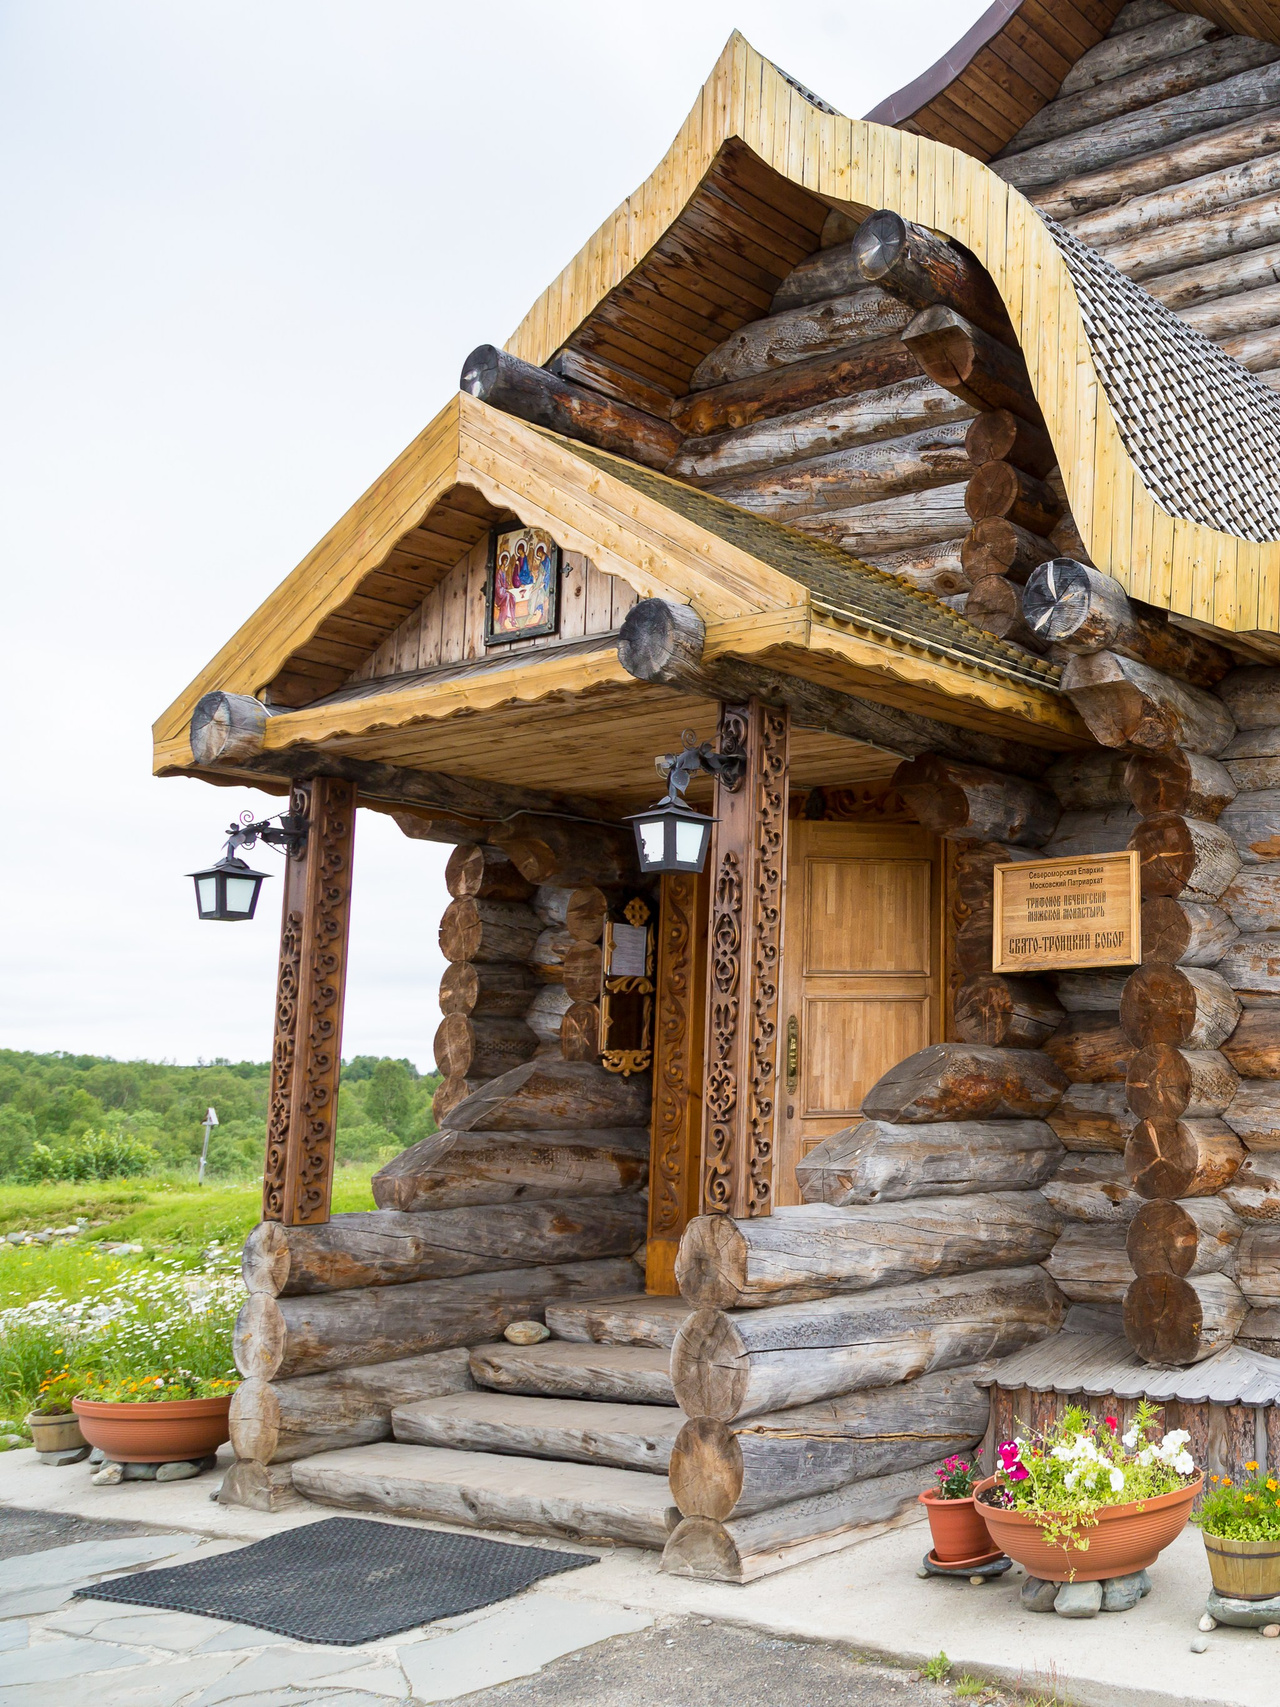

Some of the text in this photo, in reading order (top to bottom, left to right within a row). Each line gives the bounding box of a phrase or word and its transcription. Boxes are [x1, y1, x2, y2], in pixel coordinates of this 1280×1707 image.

[1029, 866, 1104, 879] Североморская Епархия
[1029, 877, 1103, 889] Московский Патриархат
[1026, 895, 1060, 909] ТРИФОНОВ
[1028, 908, 1060, 922] МУЖСКОЙ
[1009, 931, 1124, 954] СВЯТО-ТРОИЦКИЙ СОБОР
